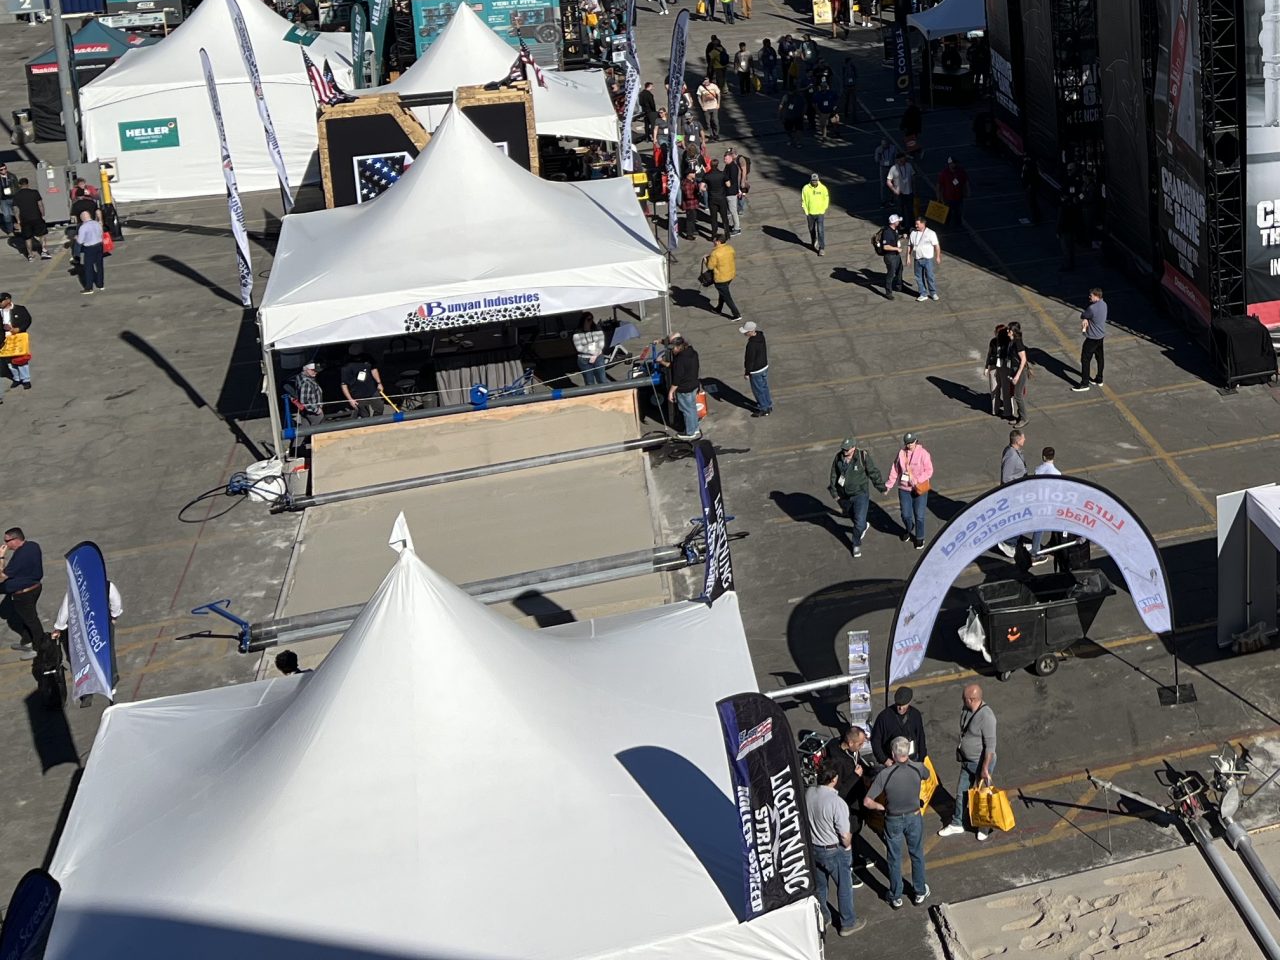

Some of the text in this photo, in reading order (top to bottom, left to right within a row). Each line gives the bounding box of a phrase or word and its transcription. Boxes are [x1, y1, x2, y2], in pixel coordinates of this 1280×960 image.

[125, 126, 169, 137] HELLER
[424, 292, 540, 318] Bunyan Industries
[85, 610, 107, 654] Screed
[754, 804, 775, 882] STRIKE
[770, 763, 811, 896] LIGHTNING
